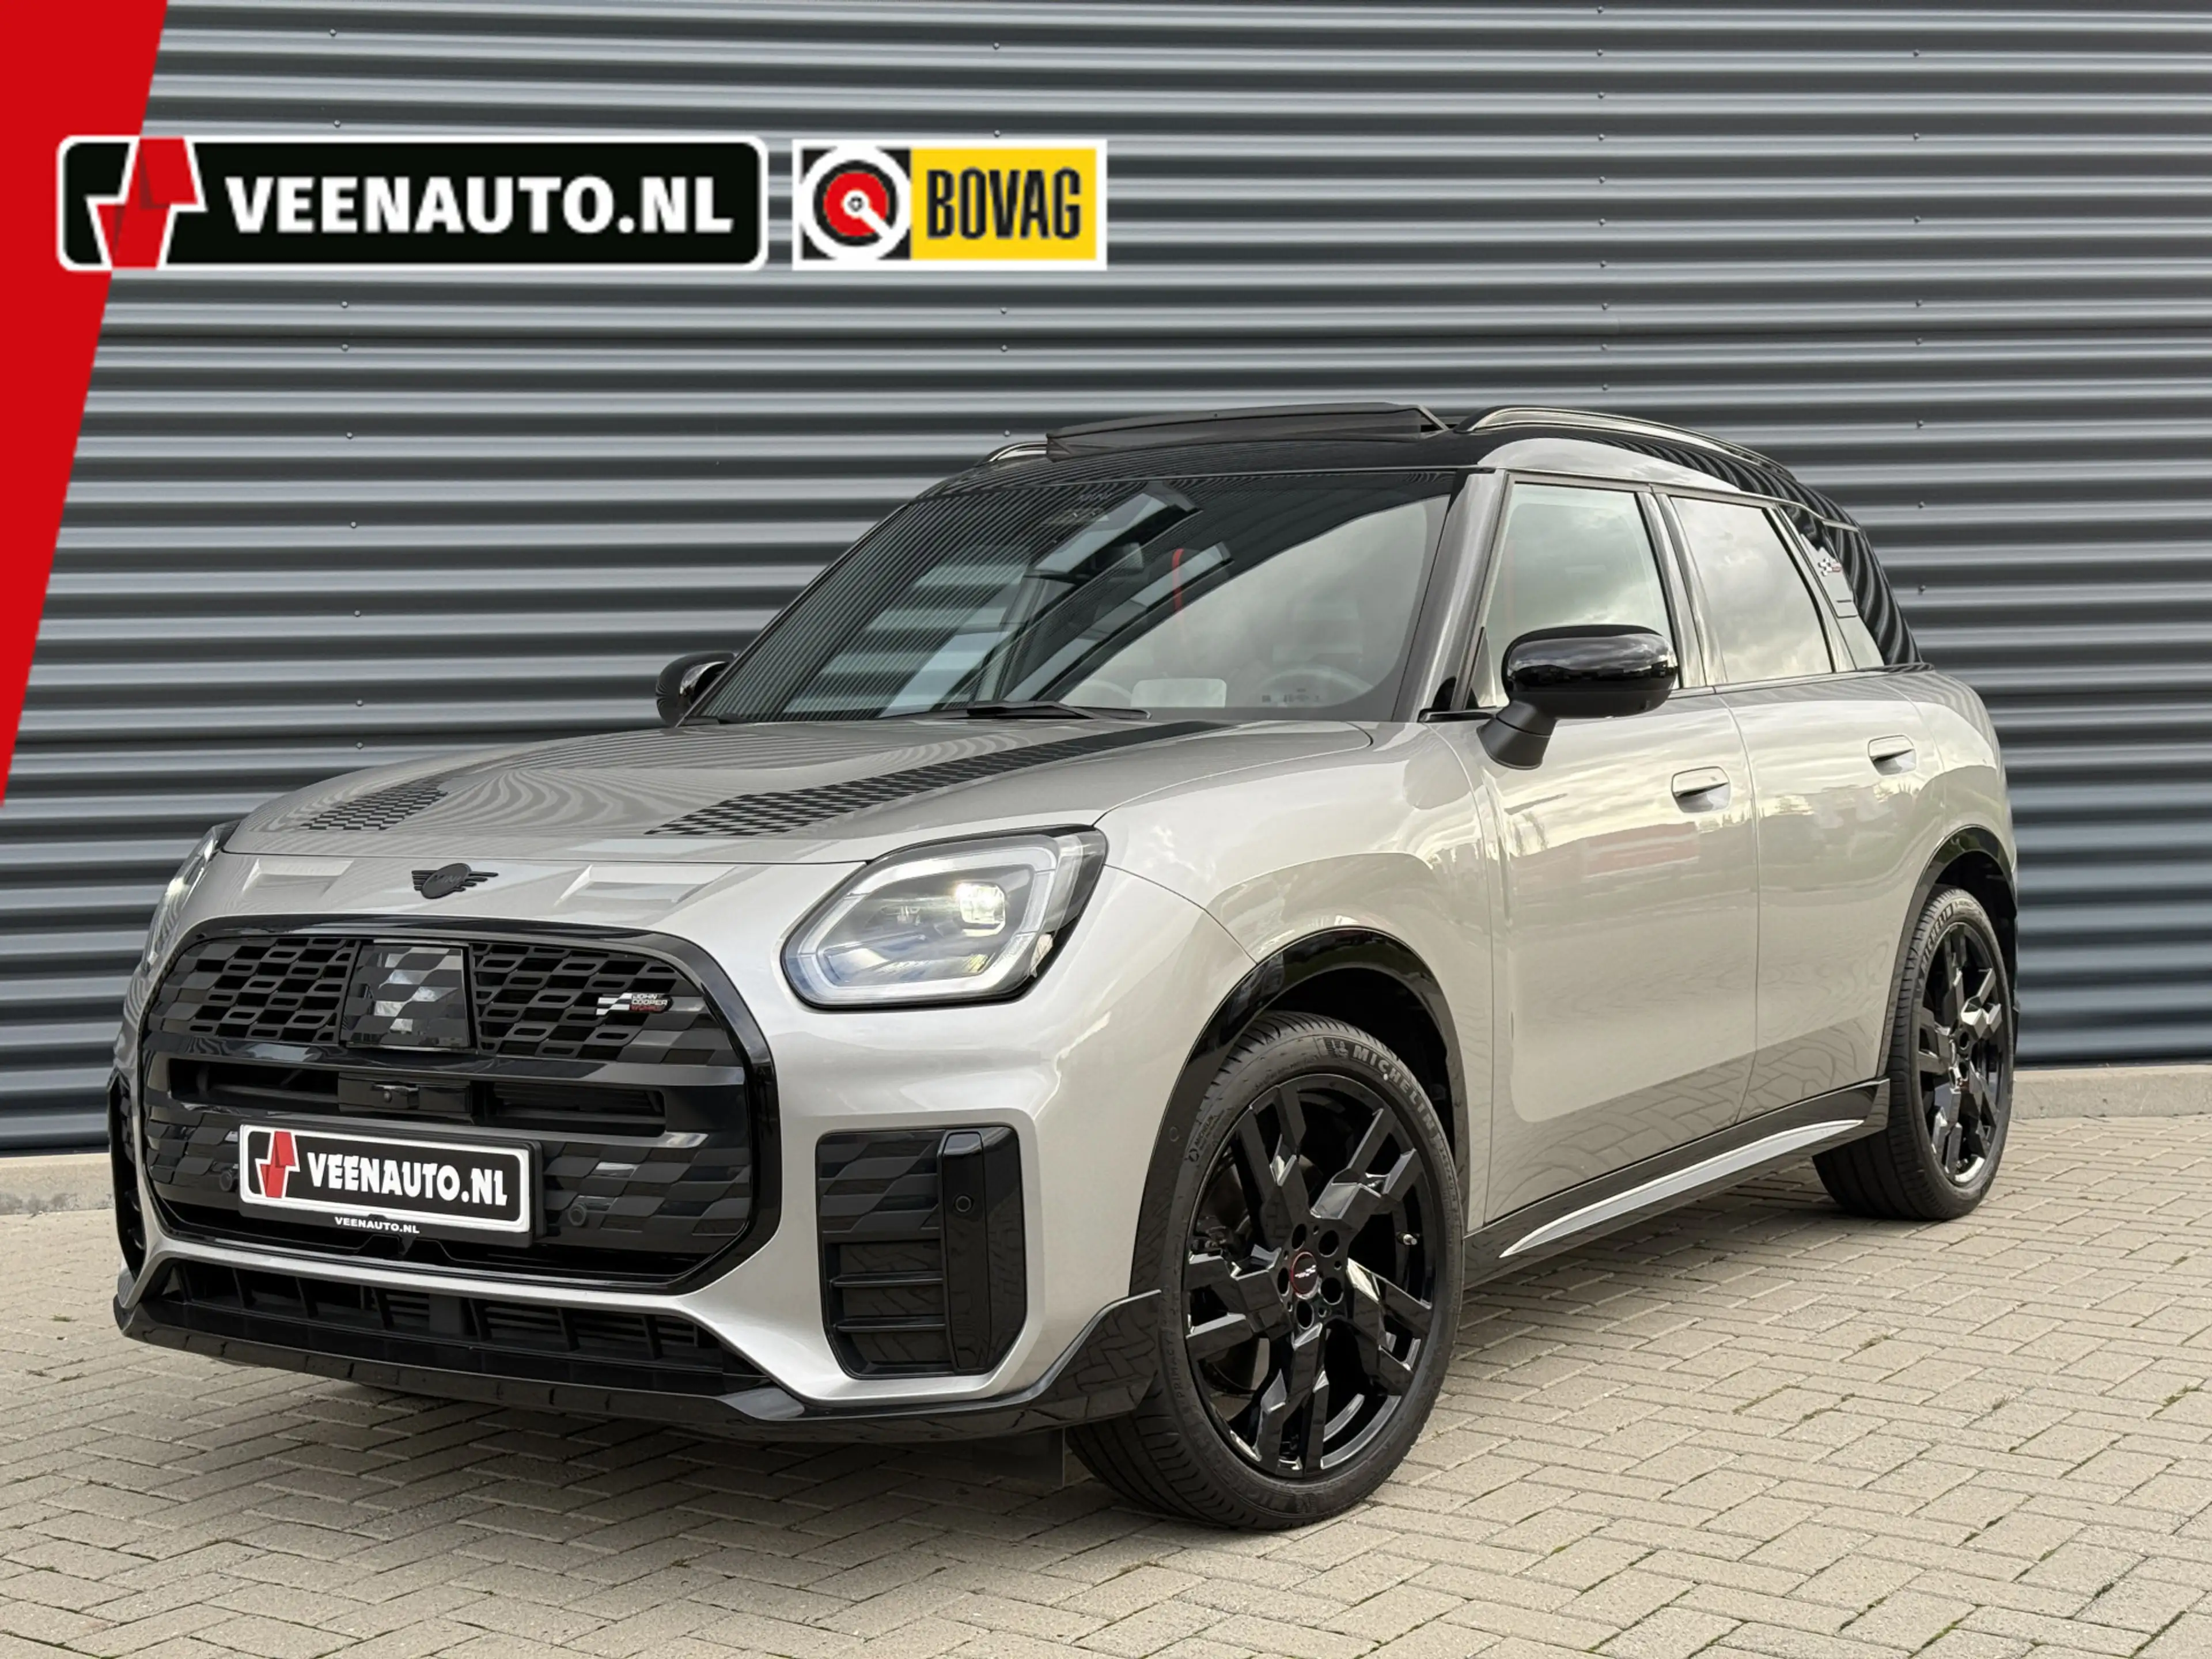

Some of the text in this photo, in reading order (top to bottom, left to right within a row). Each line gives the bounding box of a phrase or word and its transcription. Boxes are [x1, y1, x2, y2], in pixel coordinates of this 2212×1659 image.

[1353, 1044, 1435, 1130] MICHELIN
[306, 1152, 508, 1206] VEENAUTO.NL
[334, 1216, 420, 1234] VEENAUTO.NL
